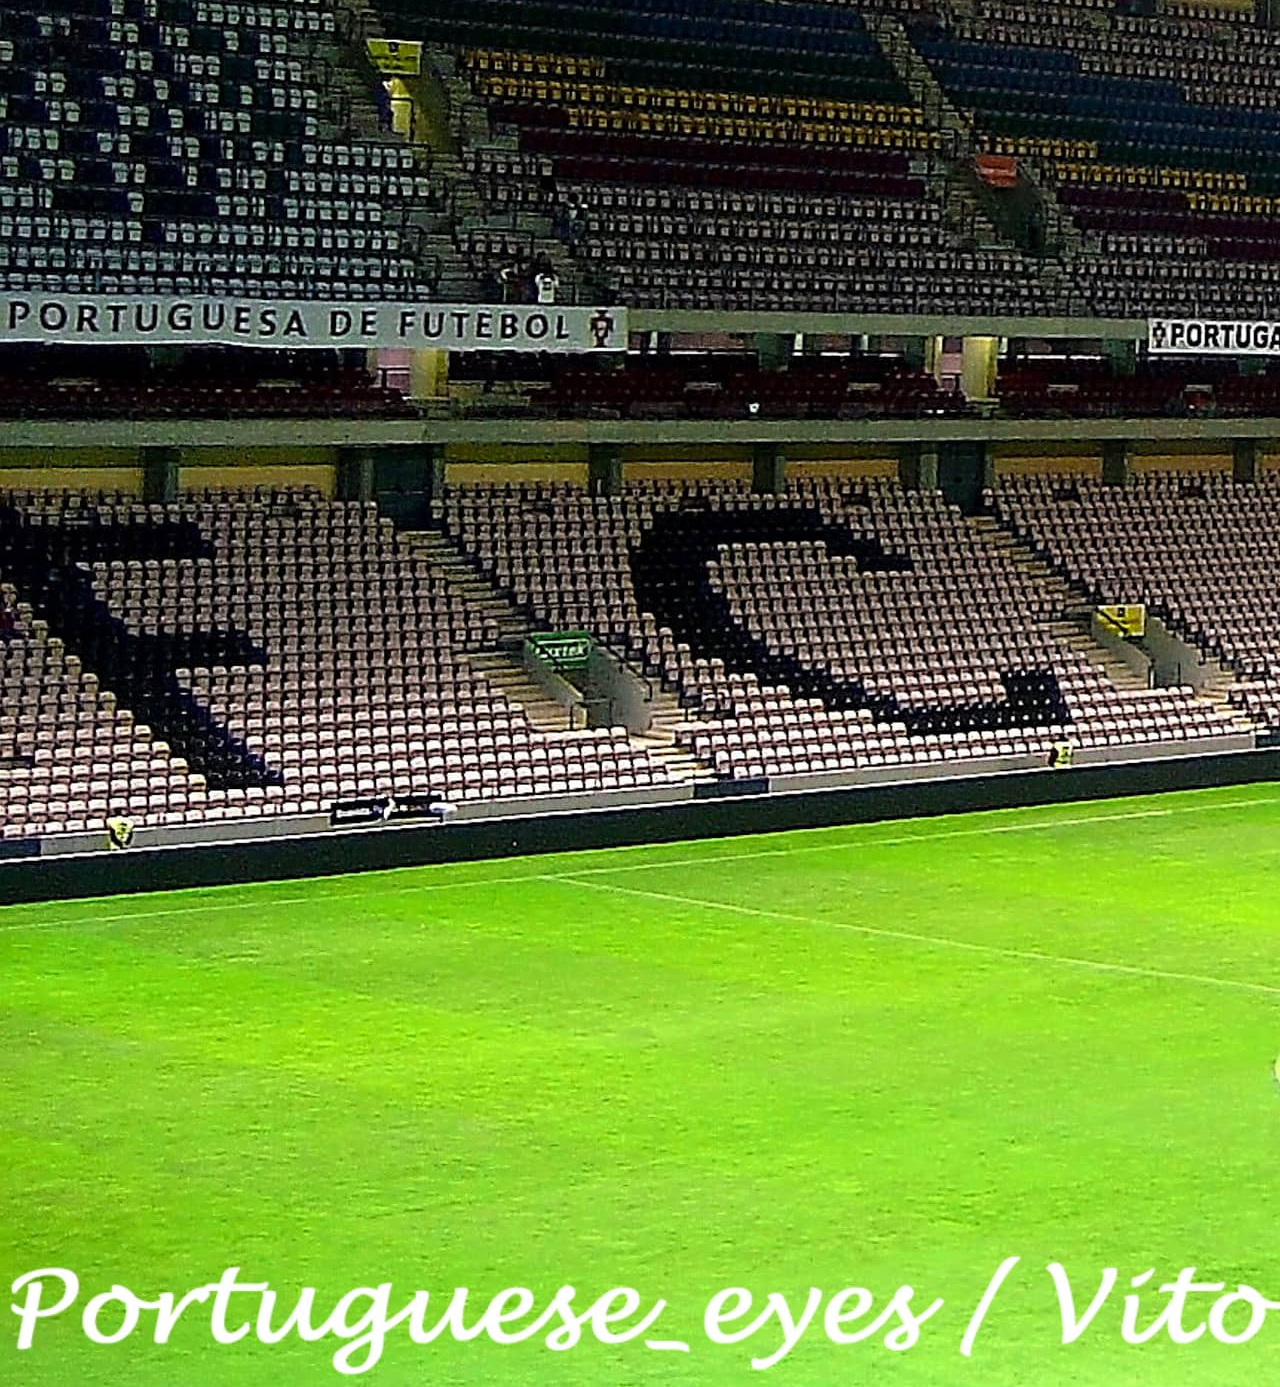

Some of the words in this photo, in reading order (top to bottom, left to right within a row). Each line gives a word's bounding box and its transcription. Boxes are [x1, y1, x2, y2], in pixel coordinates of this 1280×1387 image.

[9, 300, 306, 337] PORTUGUESA
[329, 310, 378, 337] DE
[399, 310, 570, 340] FUTEBOL
